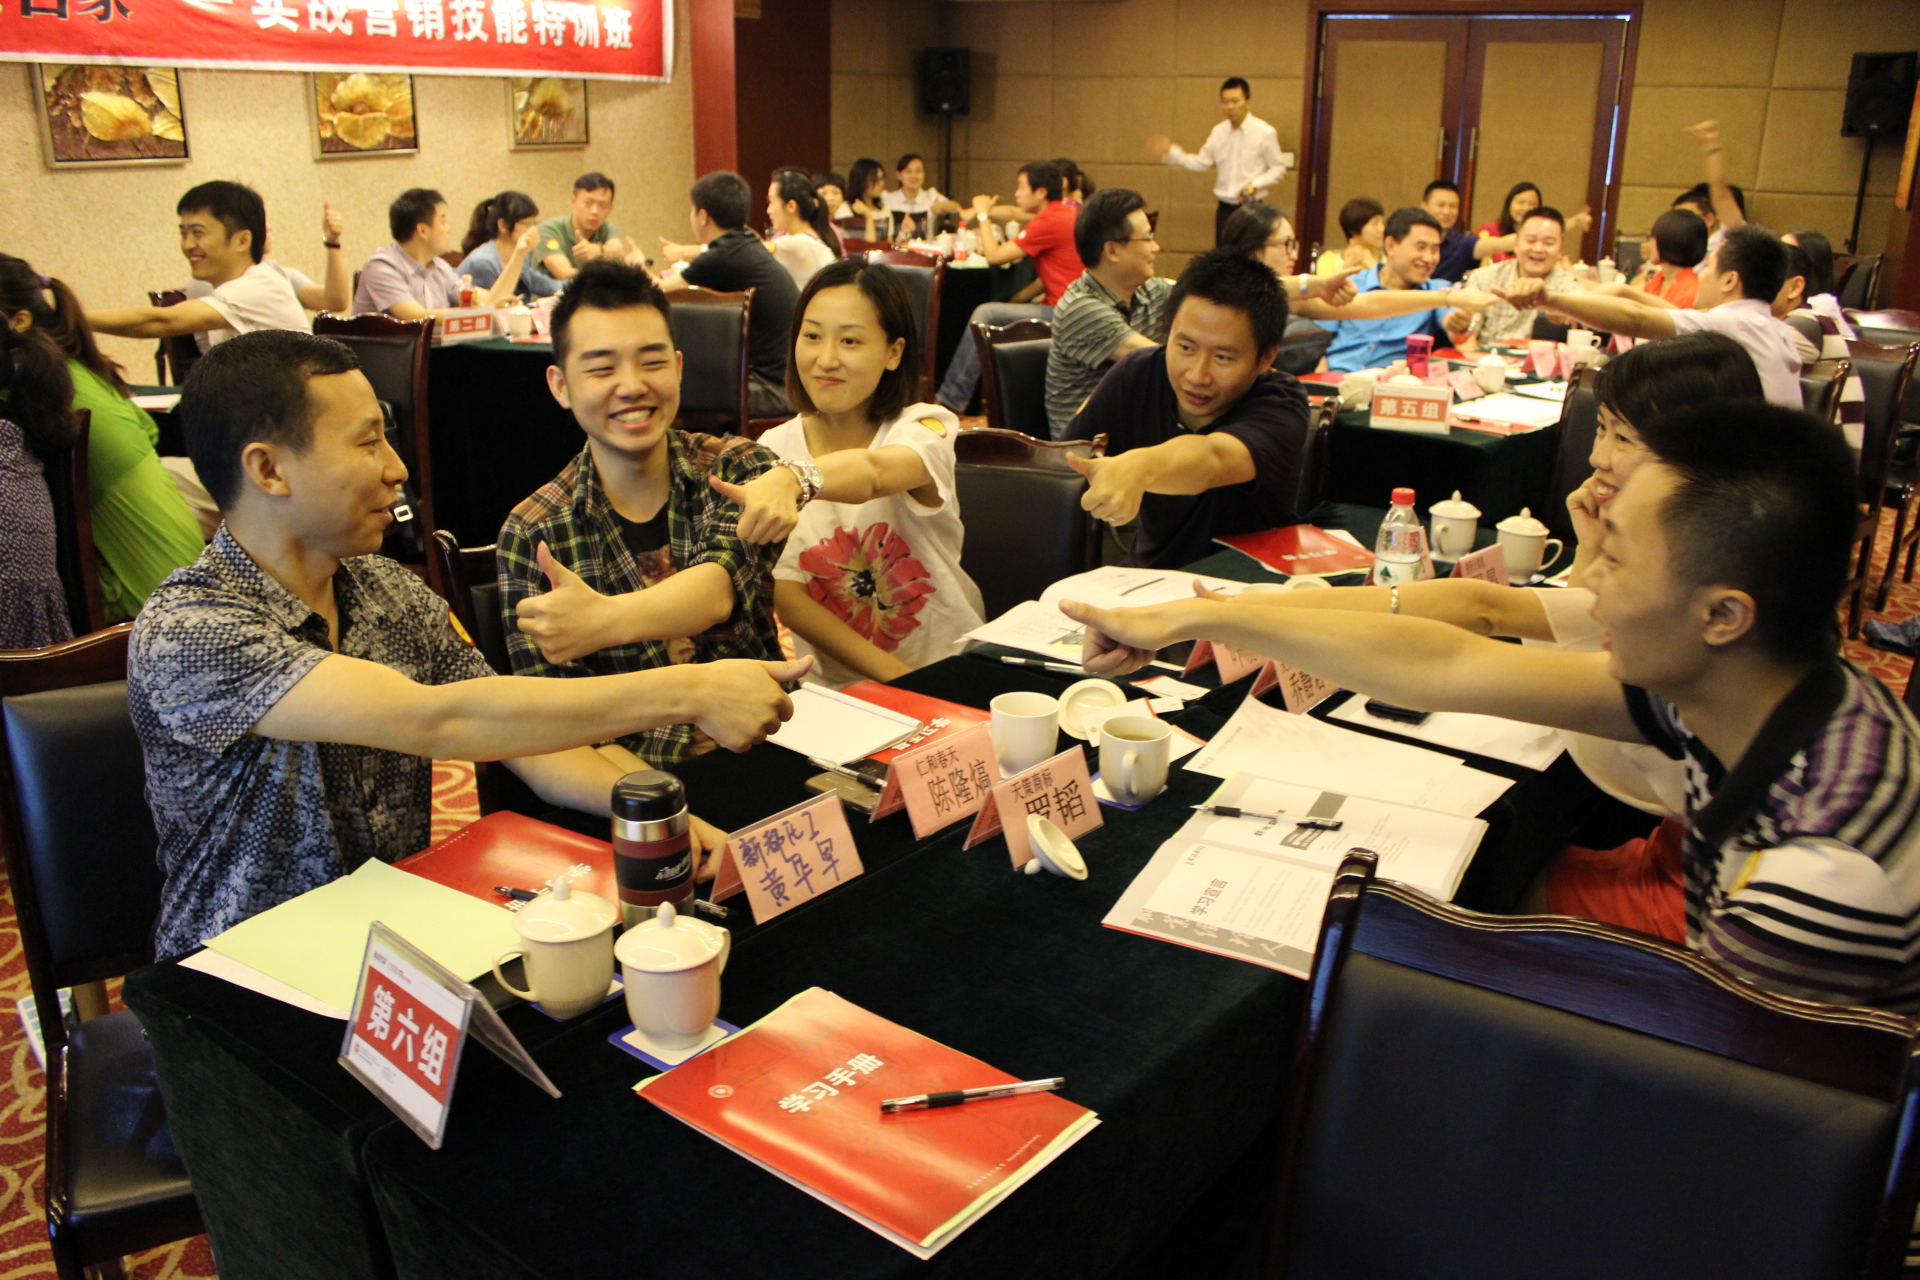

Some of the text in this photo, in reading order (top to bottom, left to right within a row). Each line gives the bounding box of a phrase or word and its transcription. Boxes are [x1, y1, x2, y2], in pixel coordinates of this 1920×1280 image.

[1380, 398, 1440, 419] 第五组
[367, 985, 449, 1087] 第六组
[778, 1052, 885, 1114] 学习手册
